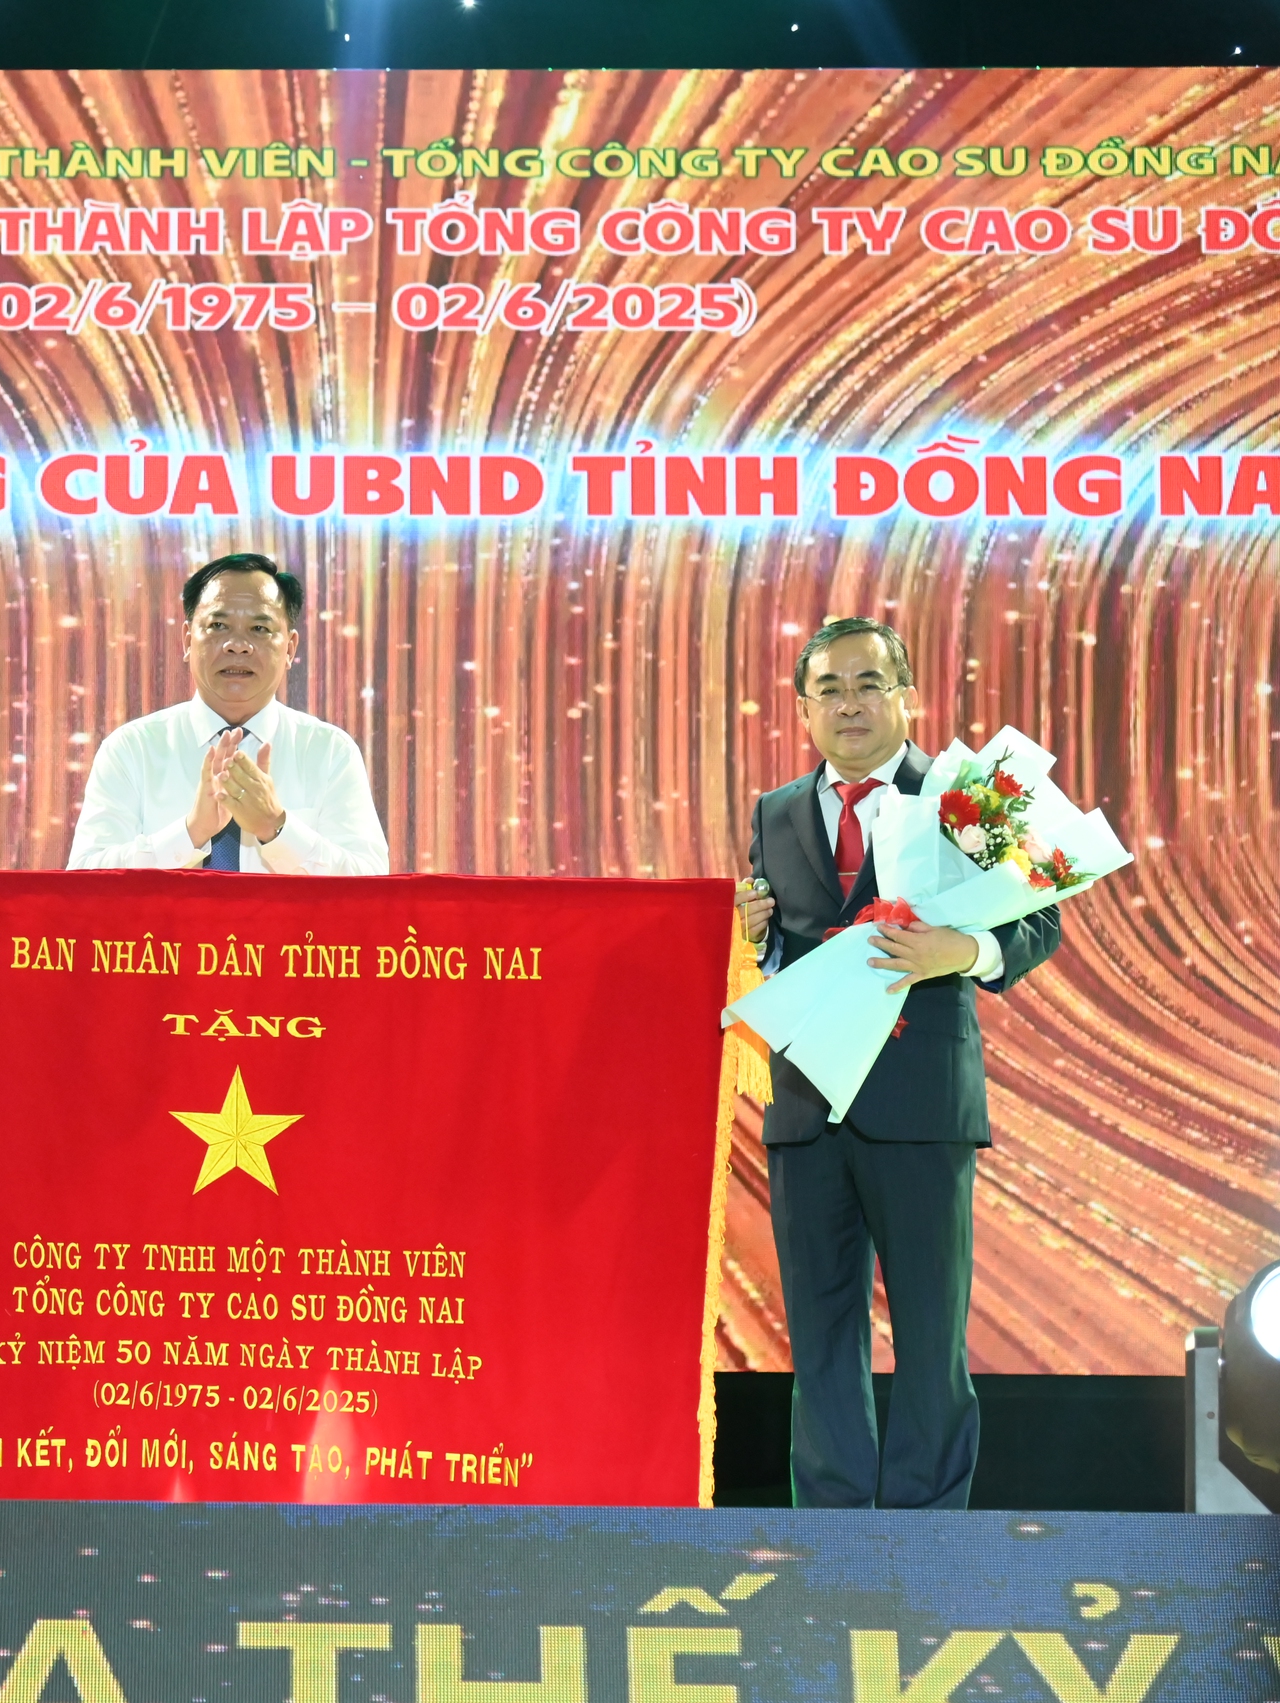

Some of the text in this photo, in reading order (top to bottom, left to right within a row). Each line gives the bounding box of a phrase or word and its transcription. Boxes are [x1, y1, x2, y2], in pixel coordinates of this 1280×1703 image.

[203, 142, 337, 178] VIÊN
[381, 137, 544, 178] TỔNG
[556, 142, 720, 178] CÔNG
[735, 147, 807, 177] TY
[821, 146, 942, 178] CAO
[955, 146, 1029, 178] SU
[1041, 136, 1216, 176] ĐỒNG
[1230, 144, 1280, 176] N
[246, 199, 373, 260] LẬP
[389, 195, 580, 254] TỔNG
[601, 200, 796, 254] CÔNG
[812, 207, 905, 254] TY
[921, 207, 1071, 254] CAO
[1086, 206, 1183, 254] SU
[394, 278, 759, 336] 02/6/2025)
[40, 437, 239, 515] CỦA
[270, 454, 545, 517] UBND
[572, 438, 800, 516] TỈNH
[833, 432, 1123, 516] ĐỒNG
[10, 936, 77, 972] BAN
[91, 931, 182, 976] NHÂN
[196, 933, 265, 978] DÂN
[279, 930, 362, 979] TỈNH
[376, 925, 468, 980] ĐỒNG
[483, 946, 542, 981] NAI
[162, 1008, 327, 1042] TẶNG
[13, 1233, 467, 1282] CÔNG TY TNHH MỘT THÀNH VIÊN
[12, 1274, 465, 1325] TỔNG CÔNG TY CAO SU ĐỒNG NAI
[37, 1333, 106, 1371] NIỆM
[116, 1339, 151, 1365] 50
[162, 1335, 230, 1367] NĂM
[239, 1337, 315, 1370] NGÀY
[326, 1343, 421, 1375] THÀNH
[431, 1347, 483, 1385] LẬP
[93, 1380, 220, 1409] (02/6/1975
[242, 1384, 378, 1415] 02/6/2025)
[17, 1425, 73, 1473] KẾT,
[85, 1424, 128, 1468] ĐỔI
[141, 1427, 194, 1475] MỚI,
[209, 1431, 277, 1472] SÁNG
[290, 1445, 351, 1483] TẠO,
[365, 1440, 433, 1480] PHÁT
